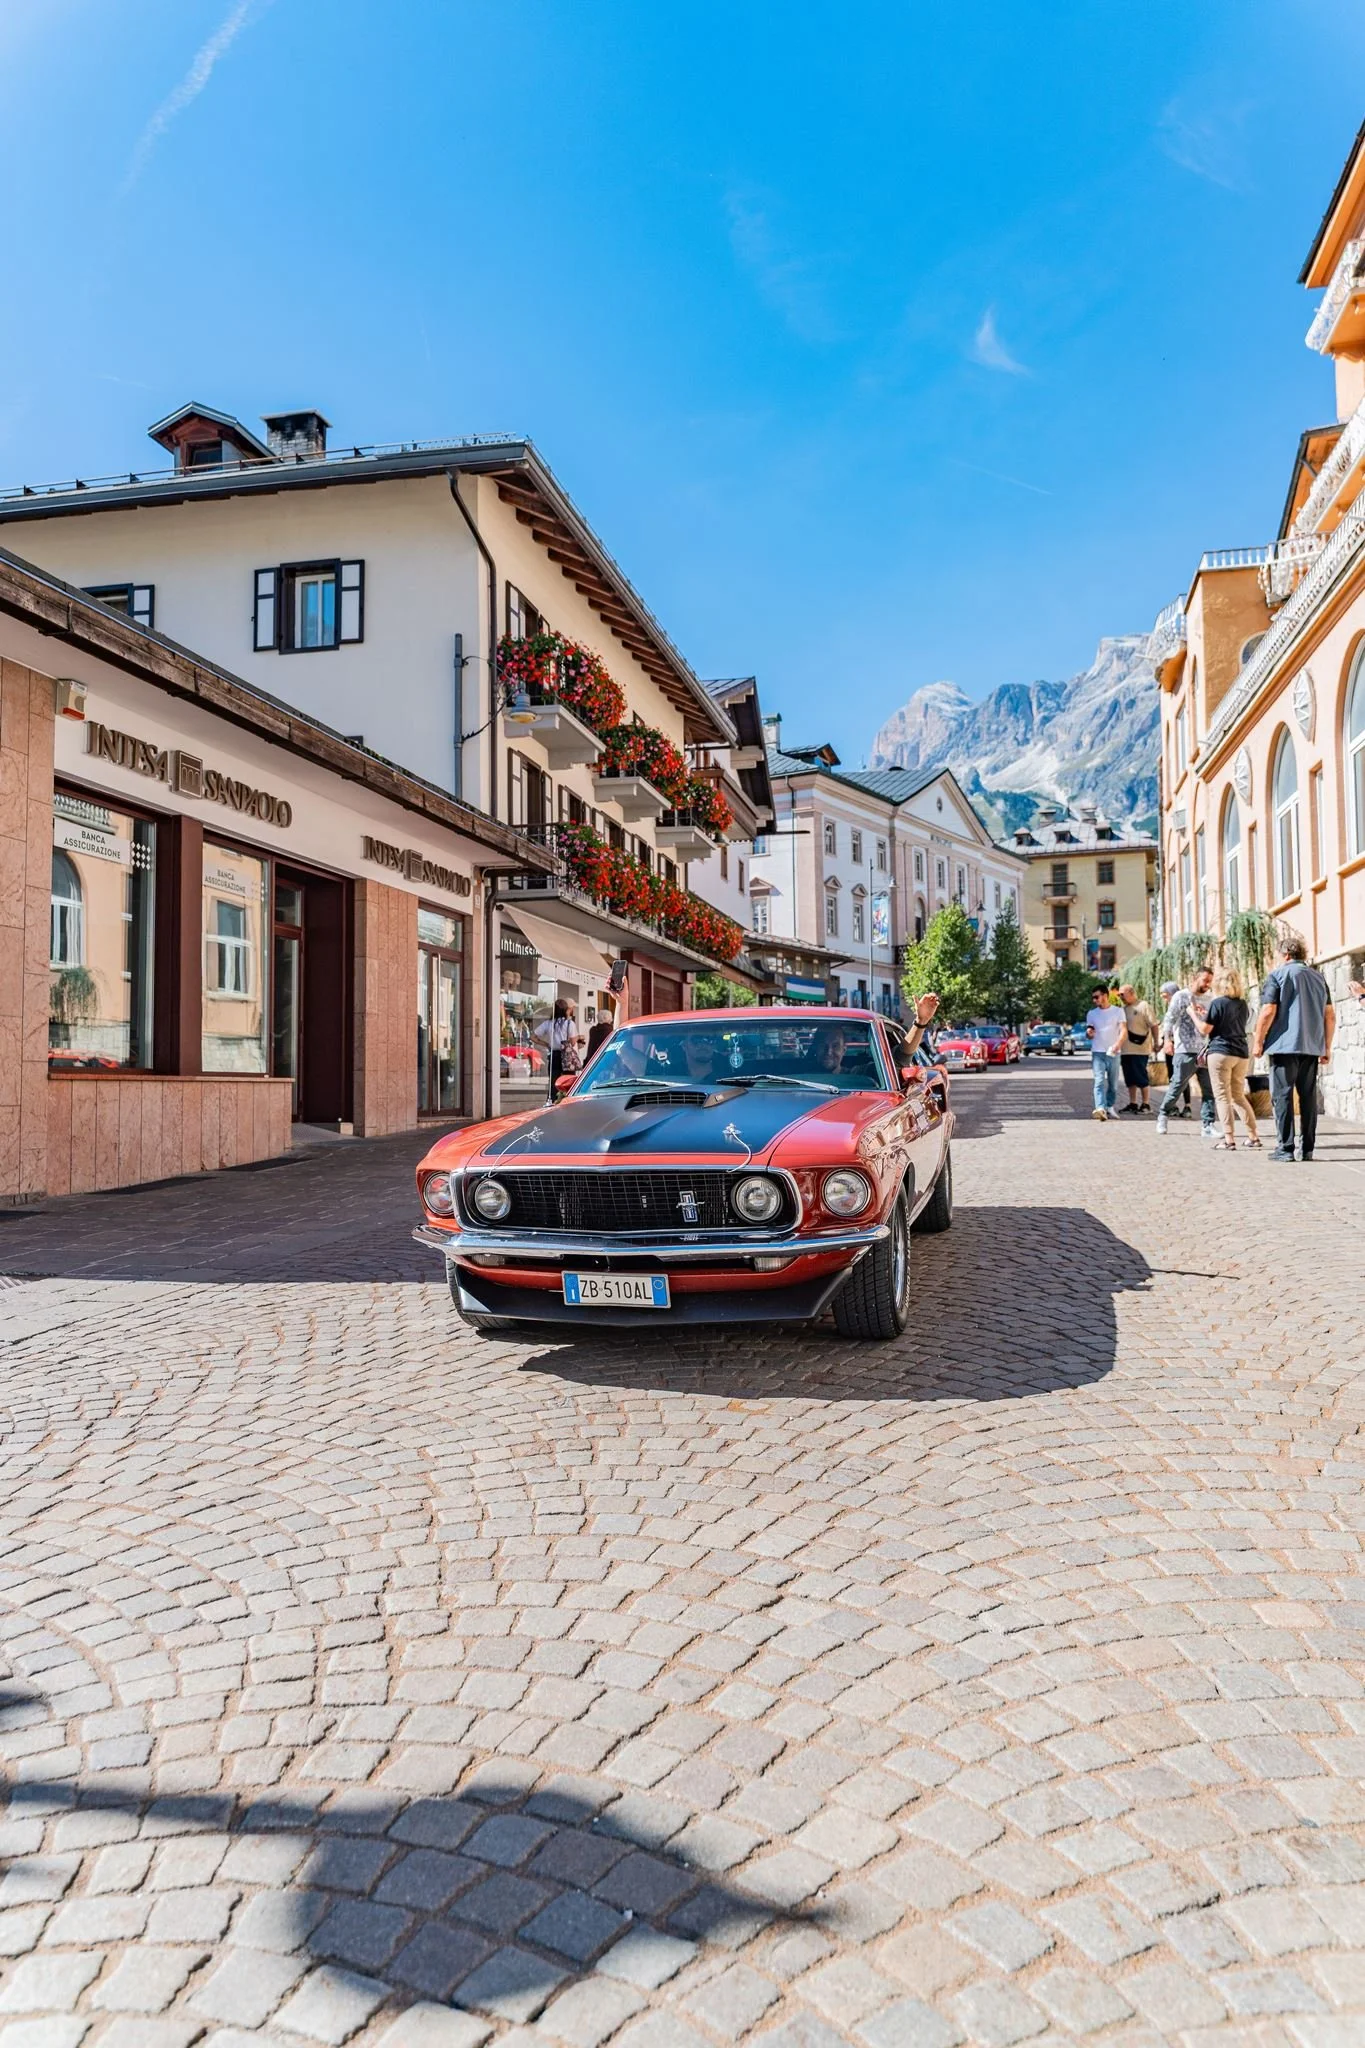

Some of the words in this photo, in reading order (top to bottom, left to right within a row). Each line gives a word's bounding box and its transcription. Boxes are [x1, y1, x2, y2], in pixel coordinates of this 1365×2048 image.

[83, 720, 169, 782] INTESA
[204, 769, 293, 829] SANPAOLO
[81, 830, 106, 845] BANCA
[63, 837, 121, 859] ASSICURAZIONE
[360, 835, 406, 873] INTESA
[204, 875, 246, 894] ASSICURAZIONE
[217, 869, 235, 881] BANCA
